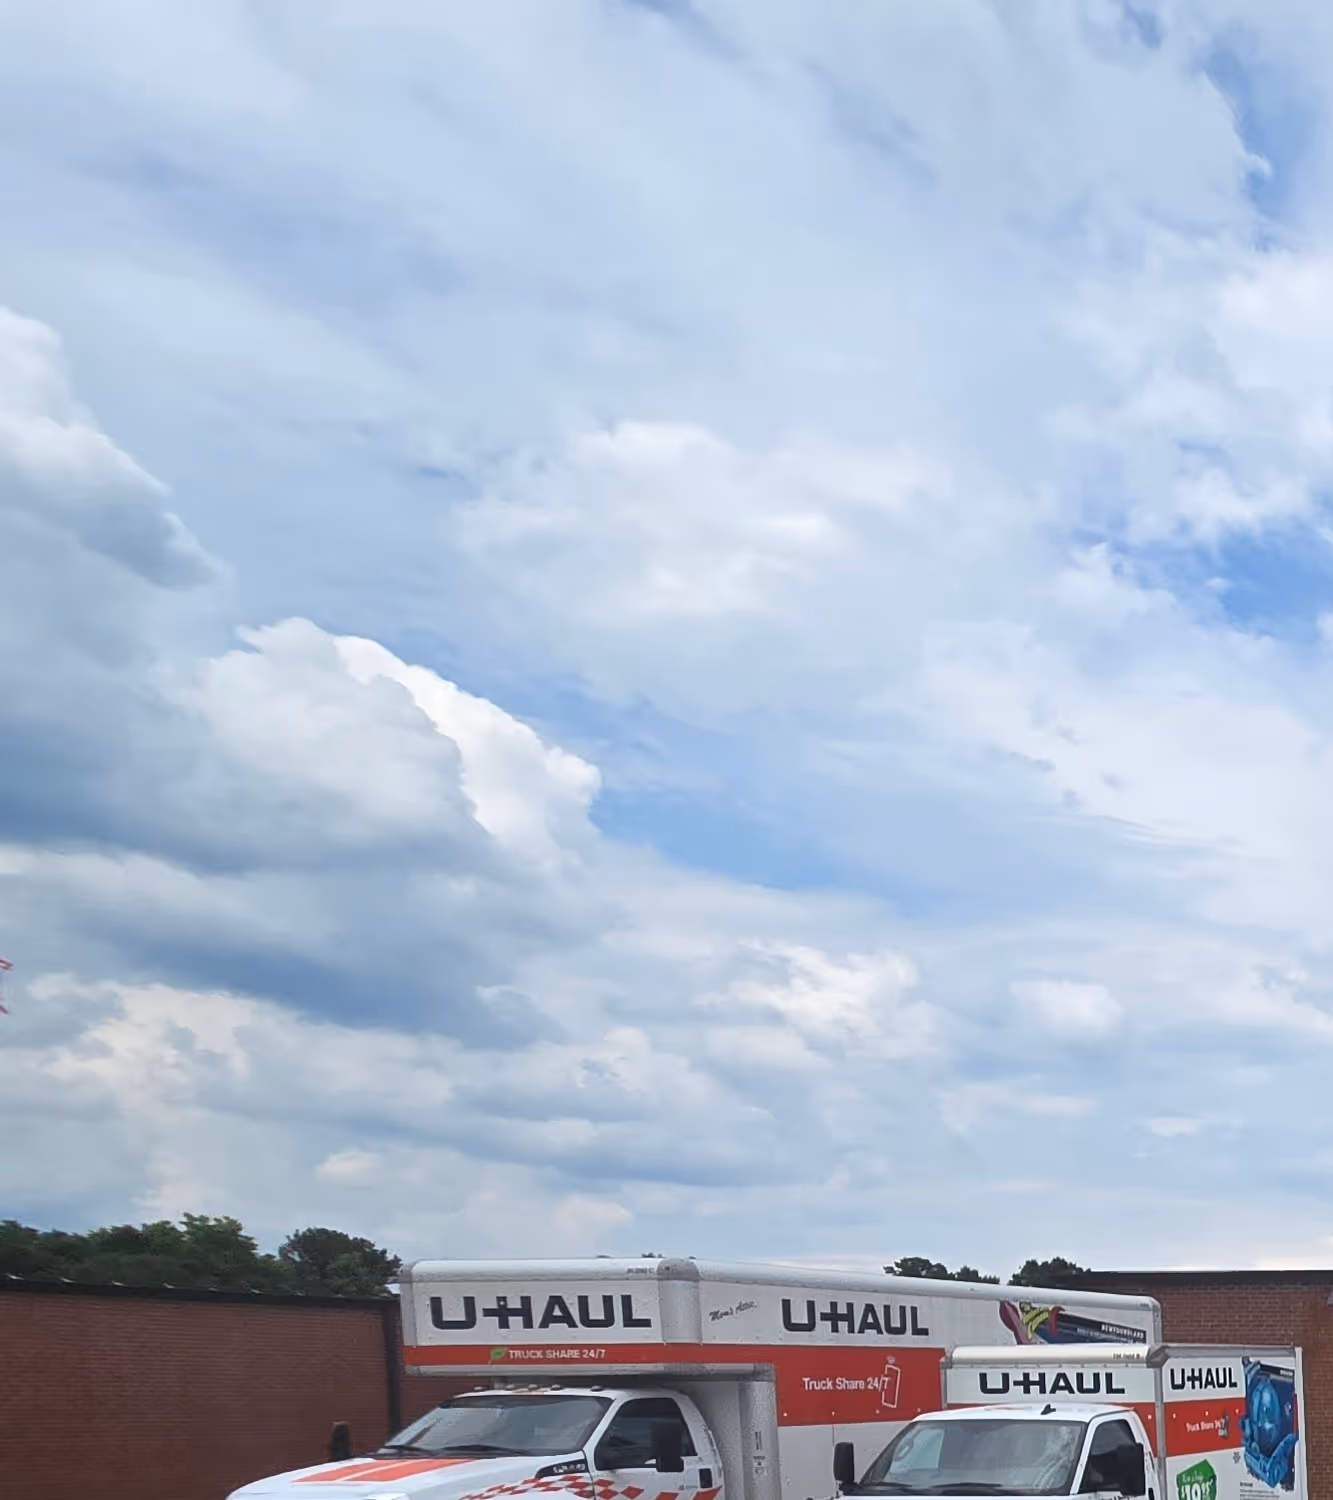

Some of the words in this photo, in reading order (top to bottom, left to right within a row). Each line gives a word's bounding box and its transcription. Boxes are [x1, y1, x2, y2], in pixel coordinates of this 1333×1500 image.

[429, 1294, 652, 1330] U-HAUL
[781, 1298, 929, 1336] U-HAUL
[508, 1349, 543, 1359] TRUCK
[545, 1349, 580, 1359] SHARE
[582, 1349, 606, 1359] 24/7
[802, 1377, 833, 1391] Truck
[835, 1376, 865, 1391] Share
[866, 1375, 891, 1393] 24/7
[979, 1372, 1125, 1395] U-HAUL
[1170, 1367, 1238, 1390] U-HAUL
